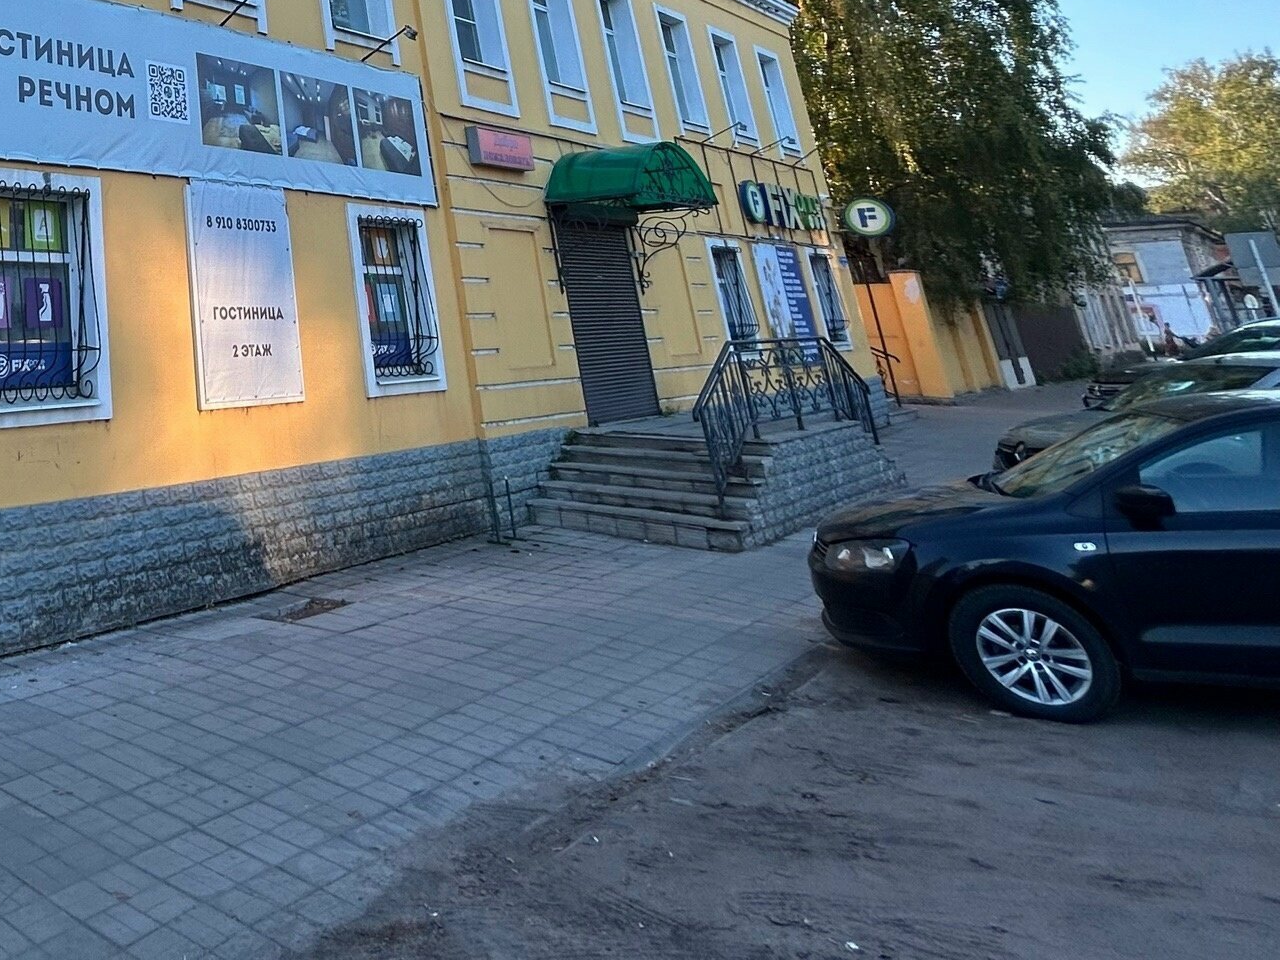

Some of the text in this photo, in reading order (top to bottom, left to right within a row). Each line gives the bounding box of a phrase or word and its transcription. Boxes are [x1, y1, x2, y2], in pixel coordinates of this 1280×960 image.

[18, 75, 136, 119] РЕЧНОМ
[206, 215, 277, 233] 8 910 8300733
[856, 207, 877, 228] F
[213, 306, 284, 321] ГОСТИНИЦА
[232, 343, 272, 358] 2 ЭТАЖ
